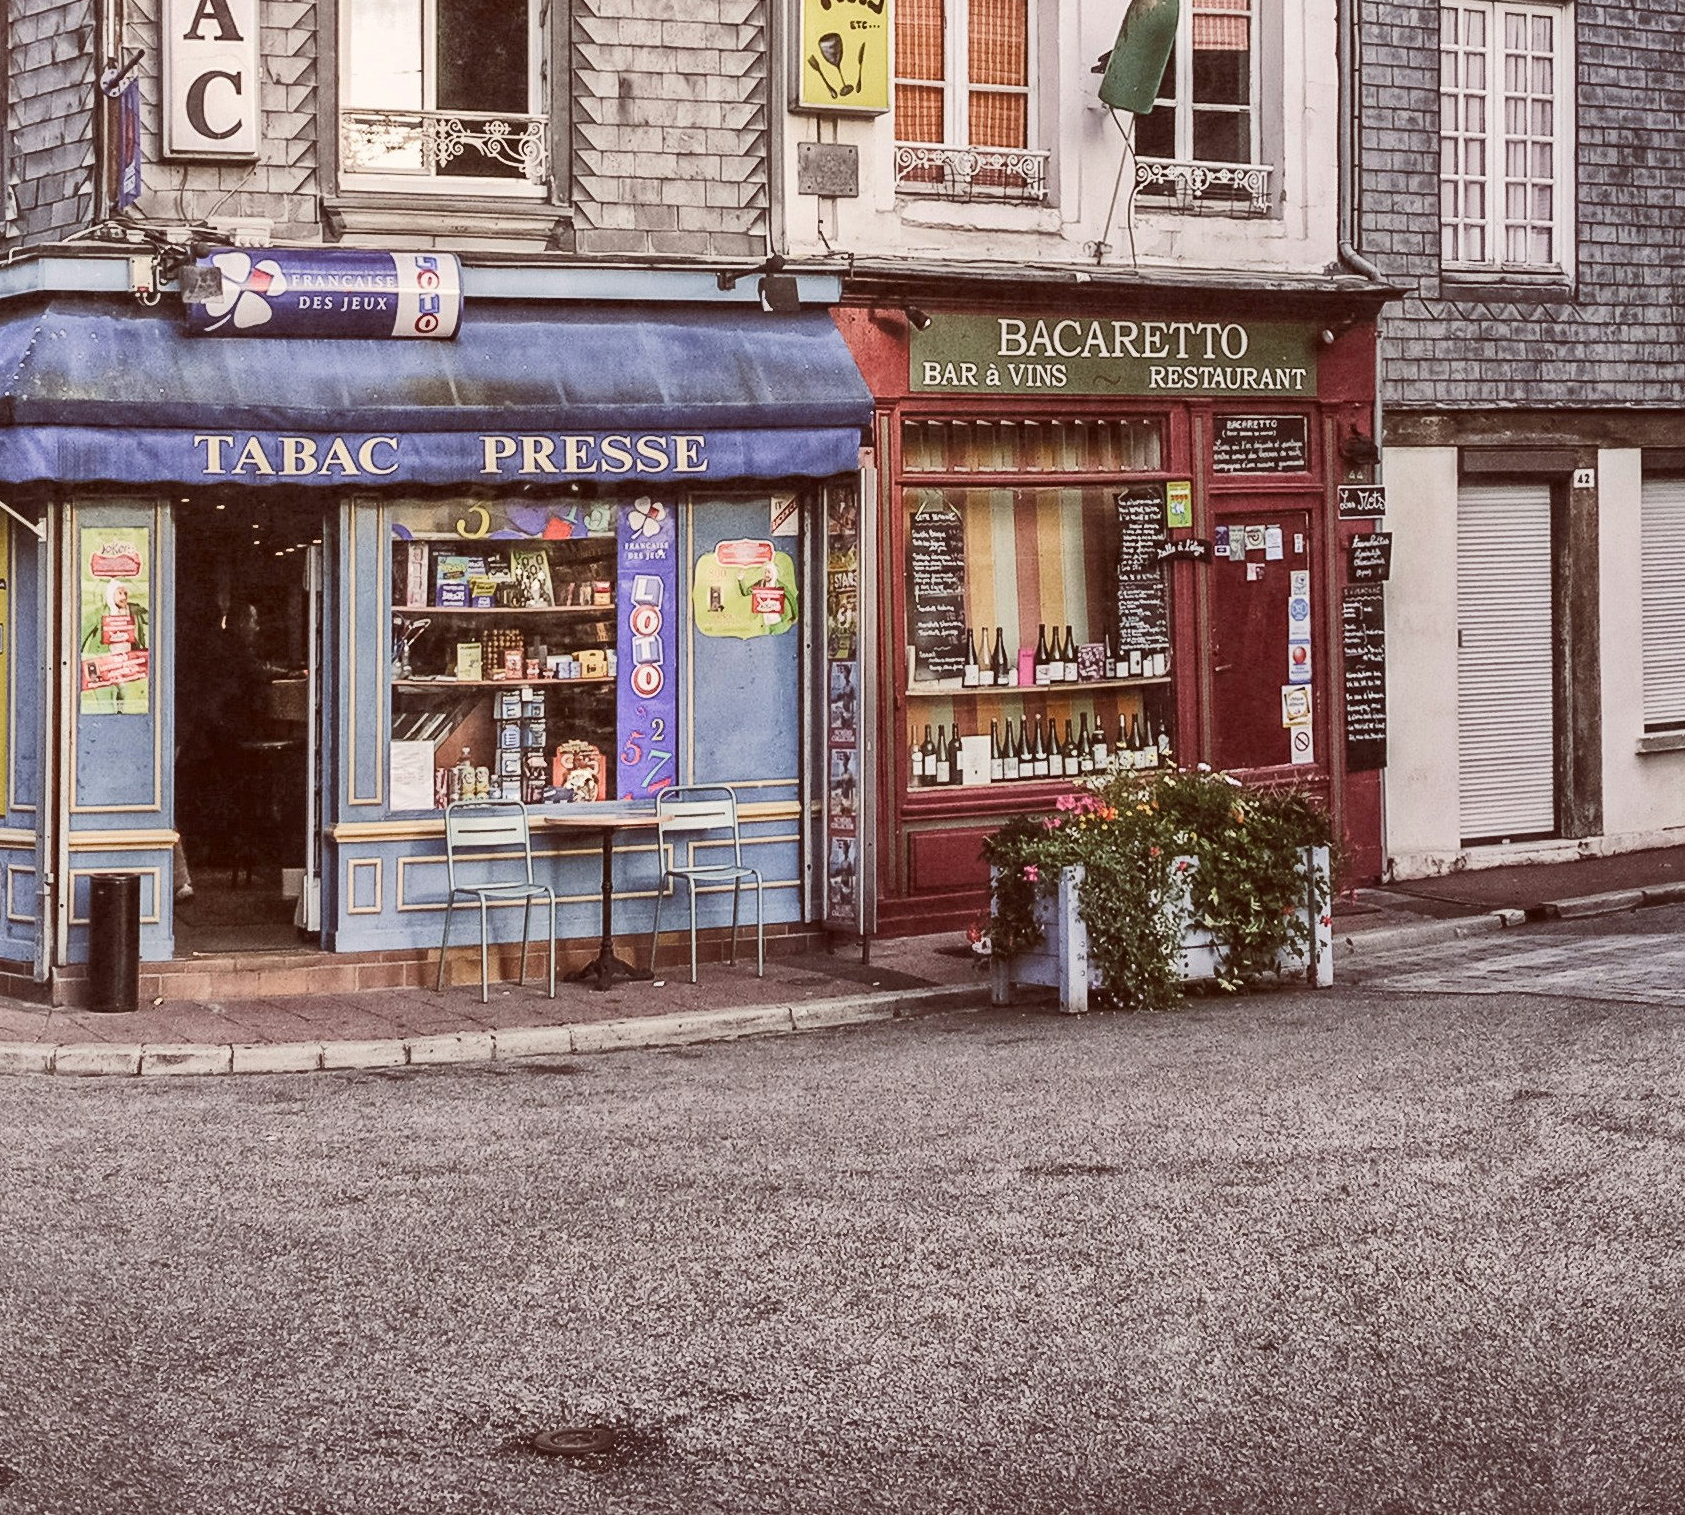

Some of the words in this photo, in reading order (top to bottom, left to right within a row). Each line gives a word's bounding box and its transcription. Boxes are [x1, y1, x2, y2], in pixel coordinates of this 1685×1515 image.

[298, 295, 333, 310] DES
[340, 295, 388, 312] JEUX
[997, 318, 1249, 360] BACARETTO
[922, 362, 978, 386] BAR
[985, 363, 1001, 386] à
[1009, 364, 1067, 388] VINS
[1148, 365, 1307, 391] RESTAURANT
[193, 434, 400, 476] TABAC
[478, 434, 710, 474] PRESSE
[1577, 473, 1590, 484] 42
[627, 551, 644, 561] DES
[631, 574, 664, 699] LOTO
[650, 718, 665, 742] 2
[620, 729, 646, 766] 5
[640, 748, 673, 788] 7
